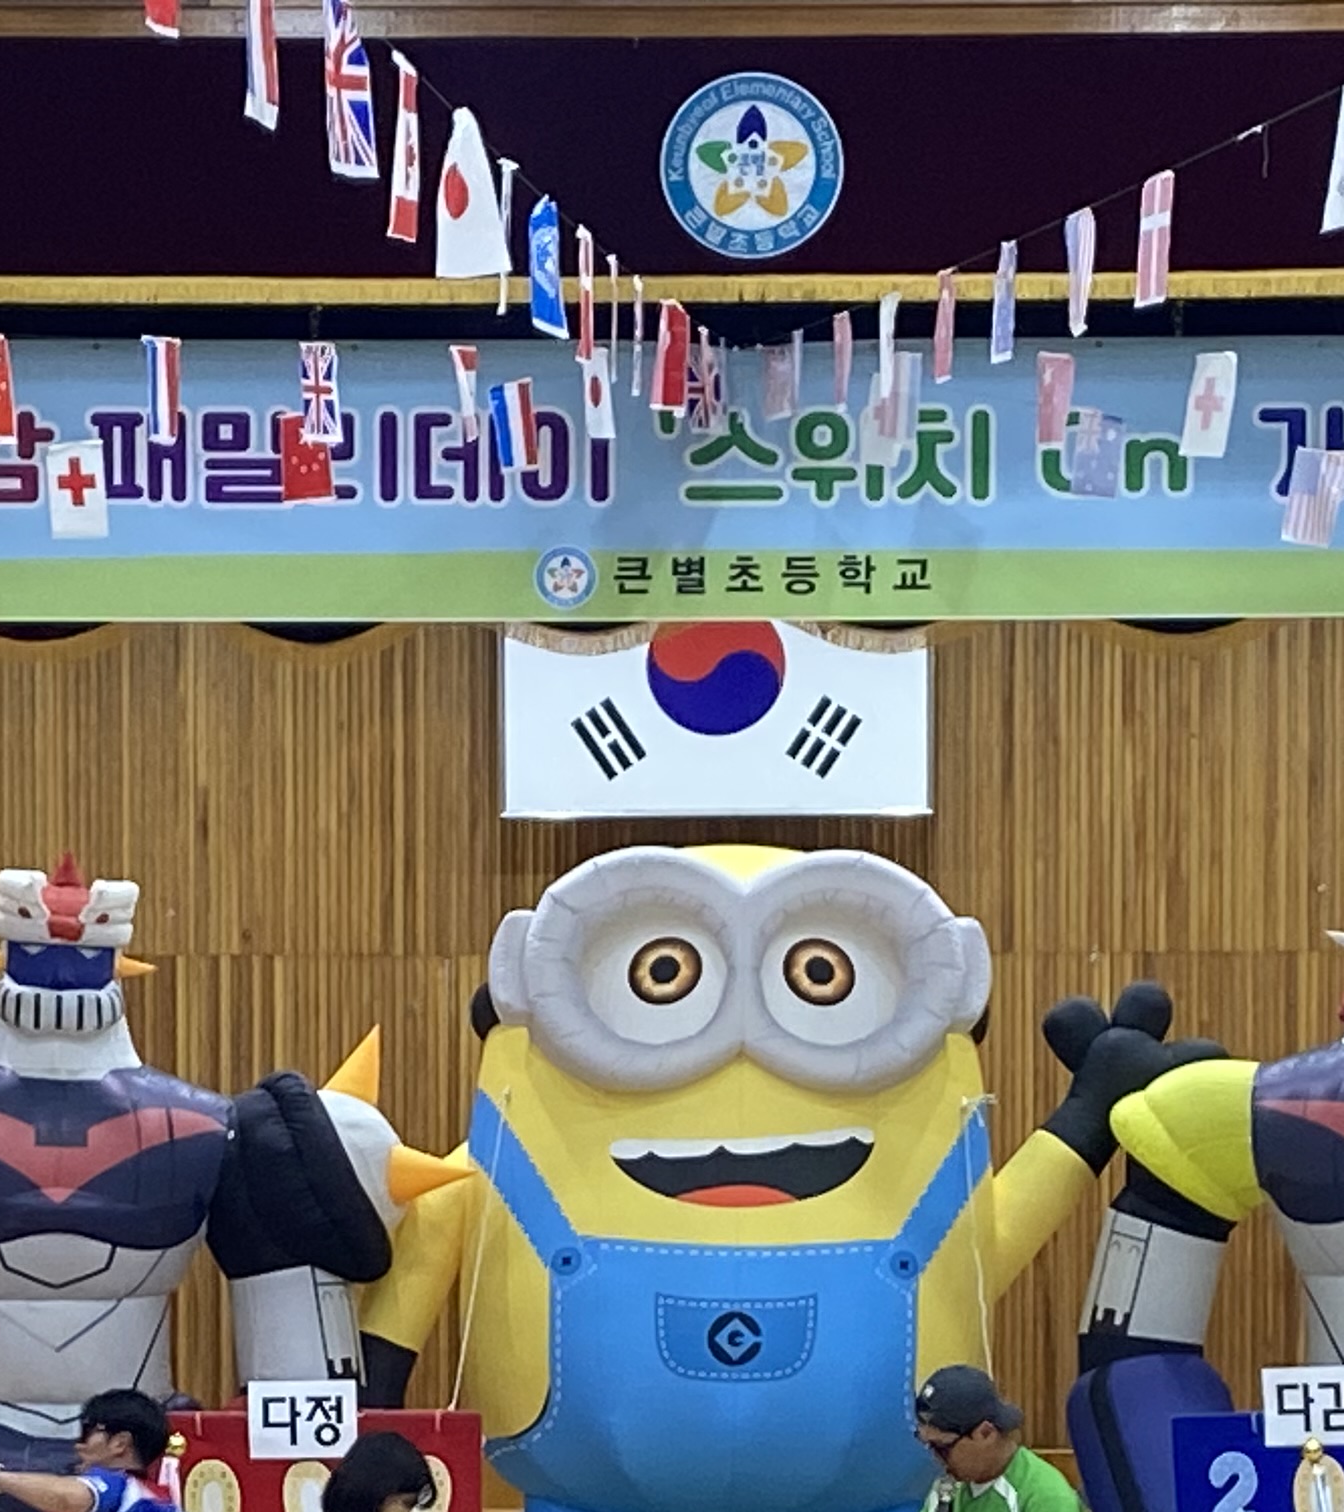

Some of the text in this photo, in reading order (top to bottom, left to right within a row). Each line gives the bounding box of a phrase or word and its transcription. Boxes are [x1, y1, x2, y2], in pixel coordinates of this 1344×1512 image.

[720, 80, 815, 120] Elementary
[810, 116, 836, 180] School
[612, 554, 934, 594] 큰별초등학교
[260, 1395, 345, 1447] 다정
